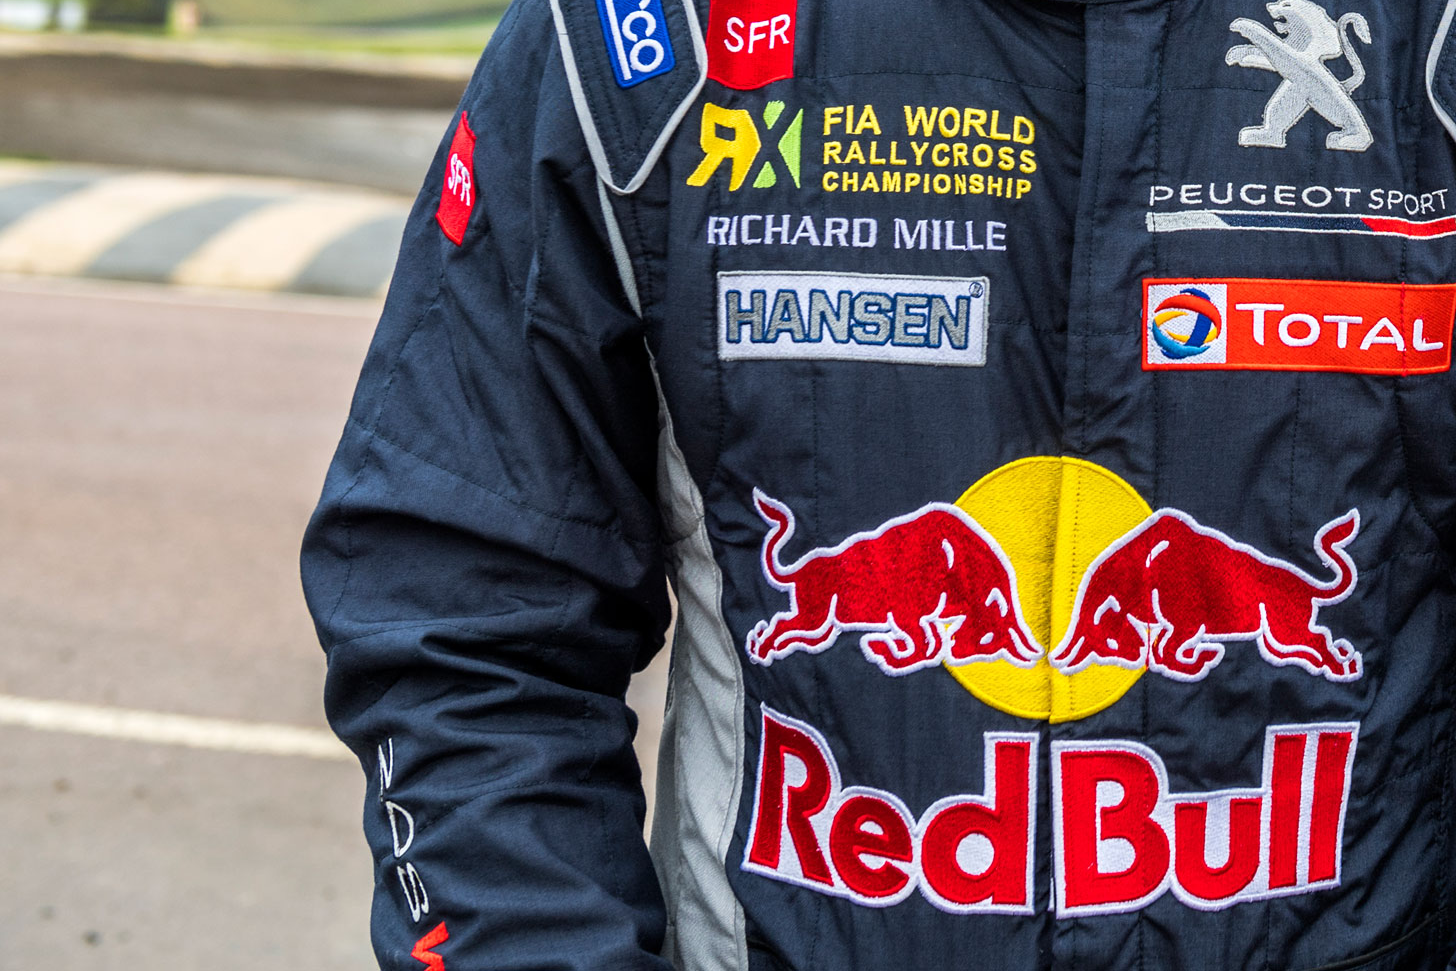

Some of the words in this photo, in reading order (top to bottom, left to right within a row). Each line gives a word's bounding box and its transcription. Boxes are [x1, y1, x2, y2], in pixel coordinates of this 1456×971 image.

[724, 13, 791, 53] SFR
[823, 104, 881, 136] FIA
[904, 105, 1035, 145] WORLD
[823, 141, 1037, 174] RALLYCROSS
[448, 153, 471, 206] SFR
[822, 171, 1032, 200] CHAMPIONSHIP
[1149, 183, 1360, 207] PEUGEOT
[1368, 188, 1448, 215] SPORT
[707, 215, 878, 248] RICHARD
[894, 218, 1007, 251] MILLE
[725, 289, 971, 349] HANSEN
[1235, 303, 1445, 353] TOTAL
[742, 702, 1040, 914] Red
[1050, 722, 1360, 919] Bull
